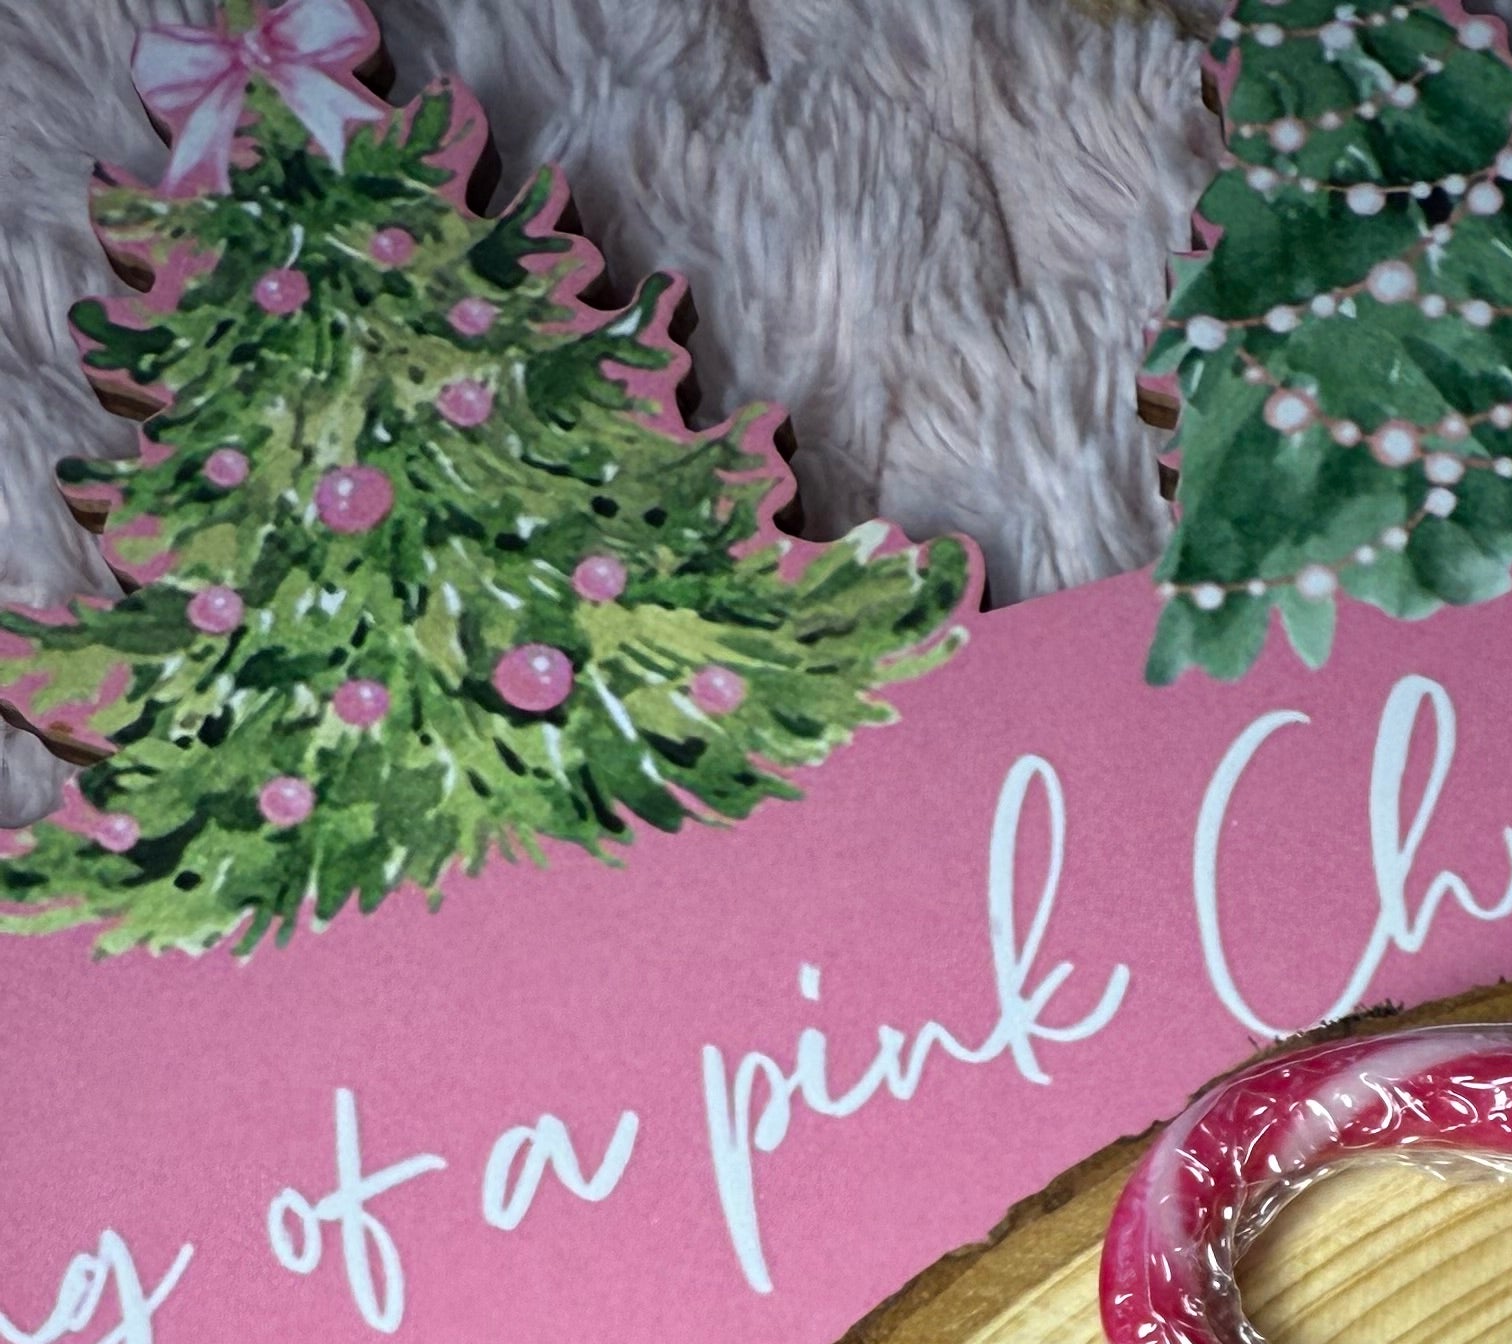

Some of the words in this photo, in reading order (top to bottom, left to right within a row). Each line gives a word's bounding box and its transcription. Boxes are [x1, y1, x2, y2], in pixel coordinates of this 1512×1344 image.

[267, 1088, 445, 1334] of
[483, 1112, 639, 1230] a
[702, 754, 1130, 1293] pink
